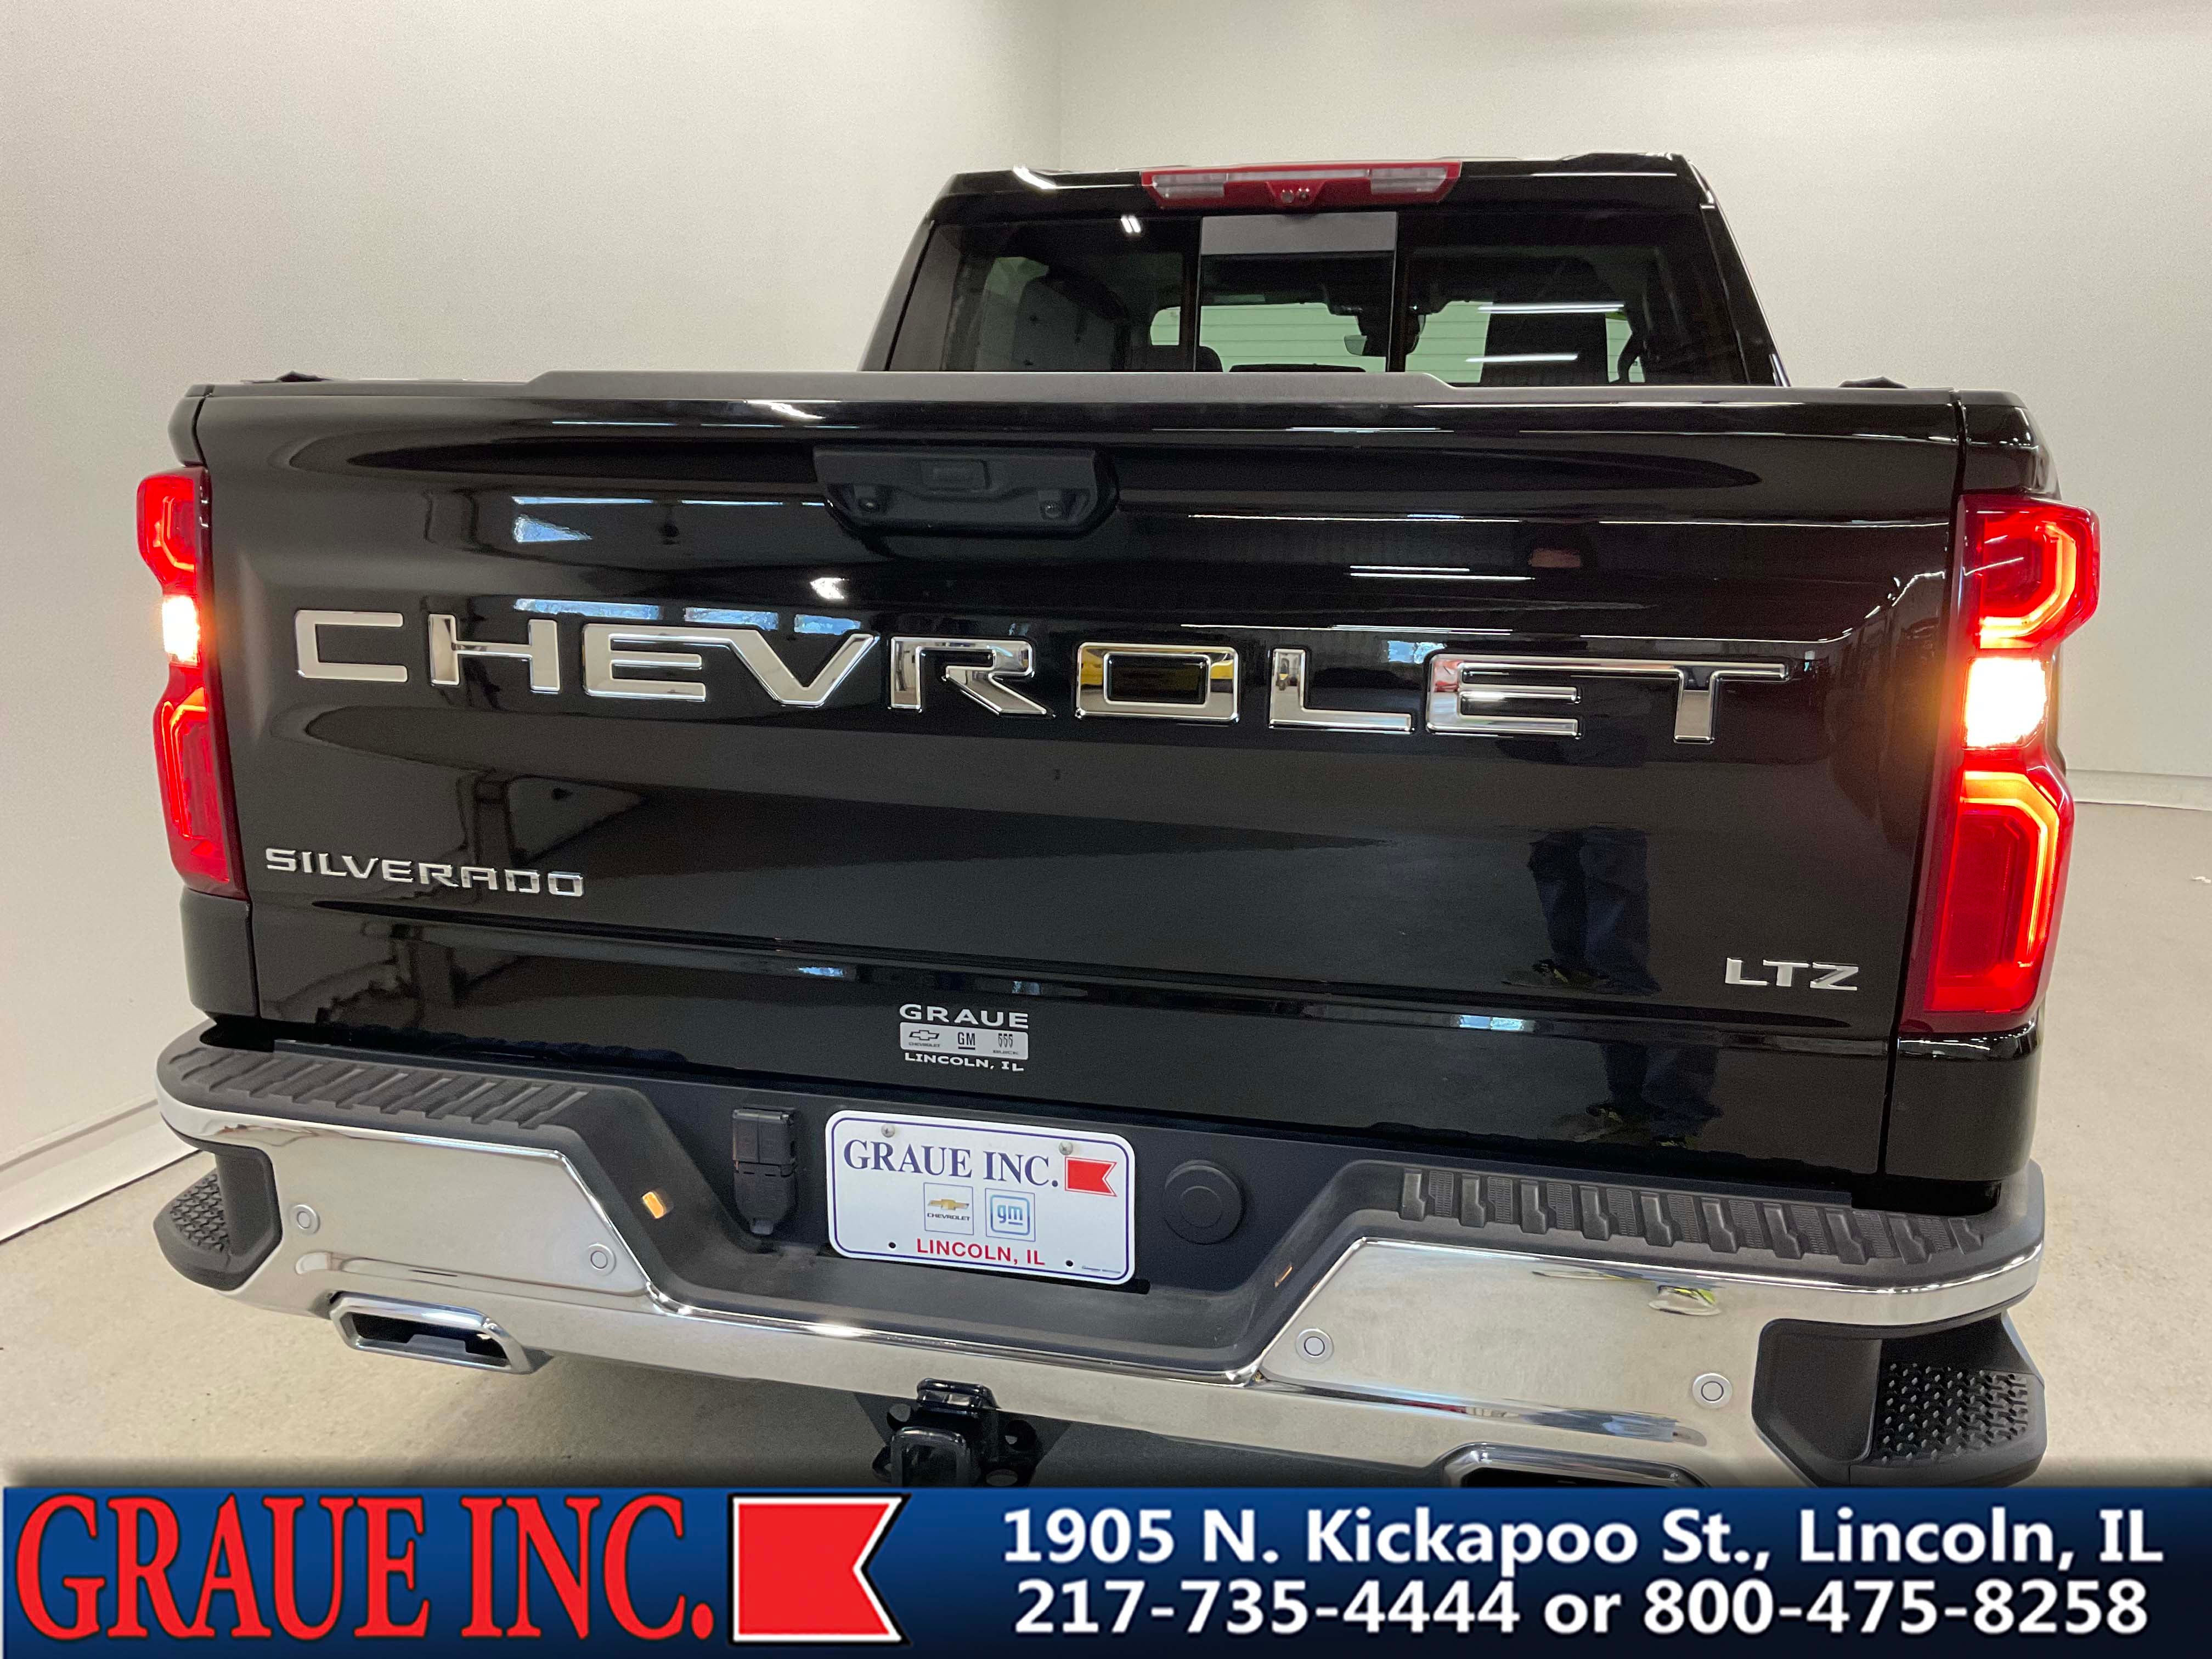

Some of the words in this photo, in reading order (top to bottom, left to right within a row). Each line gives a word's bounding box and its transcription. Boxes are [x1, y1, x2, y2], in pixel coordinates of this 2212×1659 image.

[294, 609, 1792, 744] CHEVROLET
[266, 848, 585, 896] SILVERADO
[1725, 957, 1859, 991] LTZ
[899, 1004, 1029, 1029] GRAUE
[958, 1032, 975, 1046] GM
[905, 1052, 995, 1069] LINCOLN,
[1001, 1061, 1024, 1071] IL
[843, 1139, 972, 1179] GRAUE
[983, 1151, 1058, 1187] INC.
[927, 1212, 970, 1221] CHEVROLET
[997, 1205, 1023, 1223] gm
[917, 1238, 1018, 1265] LINCOLN,
[1026, 1250, 1045, 1266] IL
